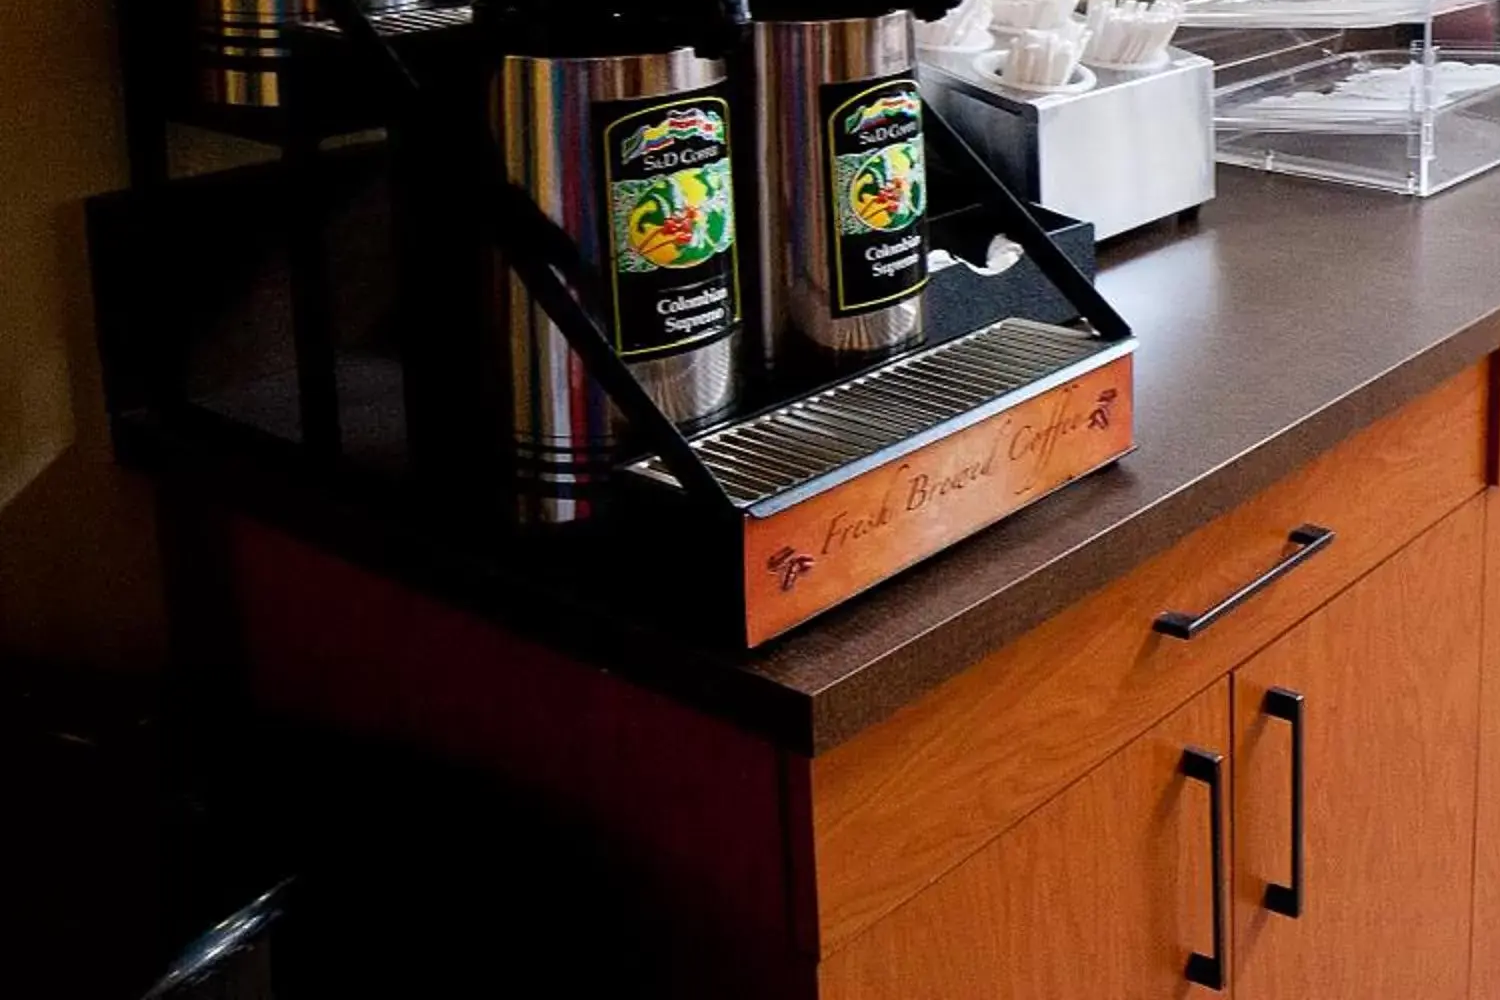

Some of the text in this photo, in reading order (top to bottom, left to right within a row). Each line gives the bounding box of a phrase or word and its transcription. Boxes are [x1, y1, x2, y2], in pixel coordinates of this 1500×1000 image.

[656, 286, 729, 315] Colombian
[821, 383, 1088, 555] Fresh Brewed Coffee
